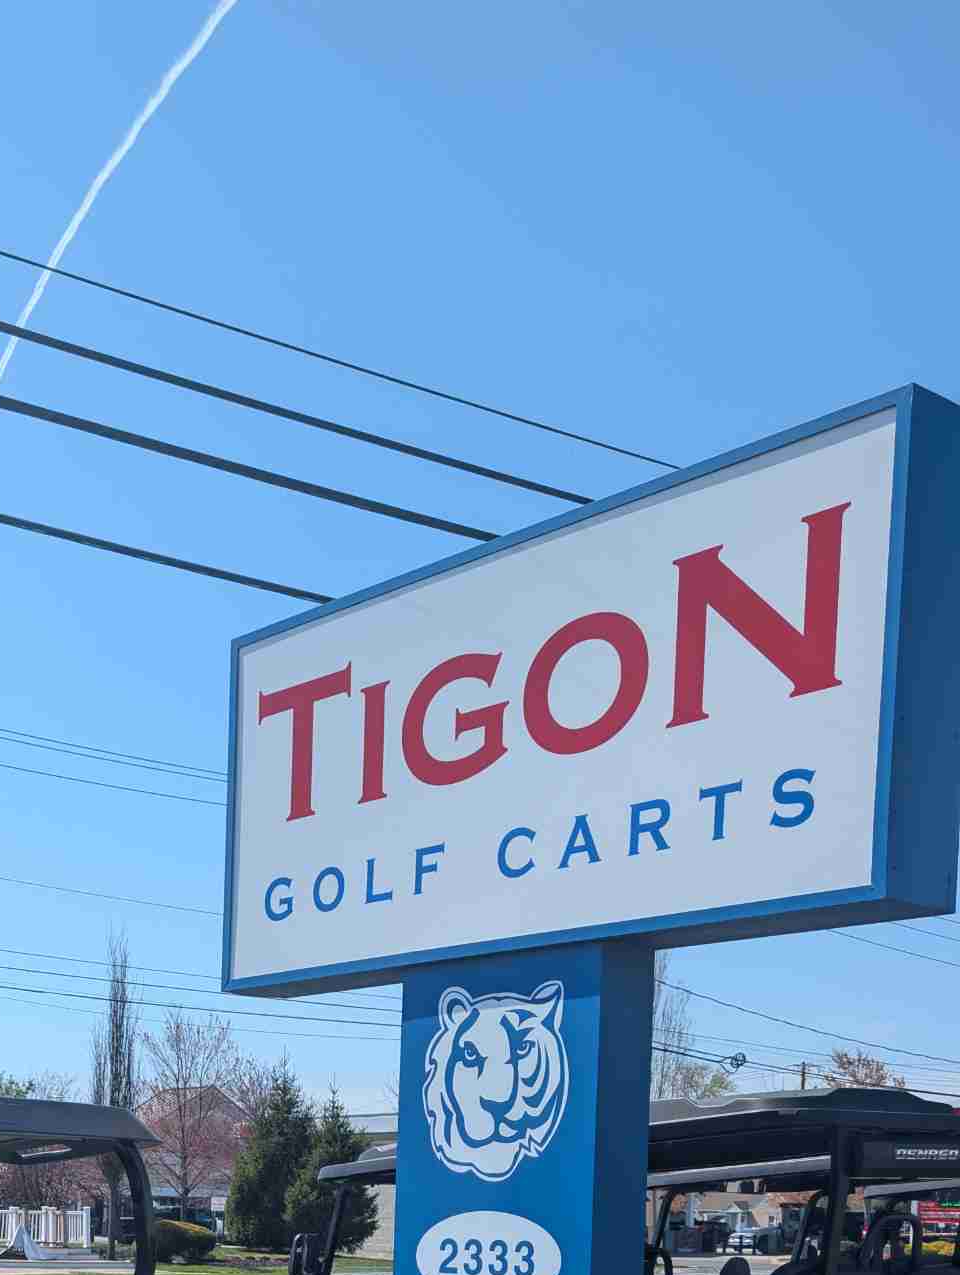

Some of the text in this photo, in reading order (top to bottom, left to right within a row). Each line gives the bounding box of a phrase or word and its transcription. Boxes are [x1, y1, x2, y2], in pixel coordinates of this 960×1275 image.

[258, 502, 852, 822] TIGON
[264, 768, 817, 922] GOLF CARTS
